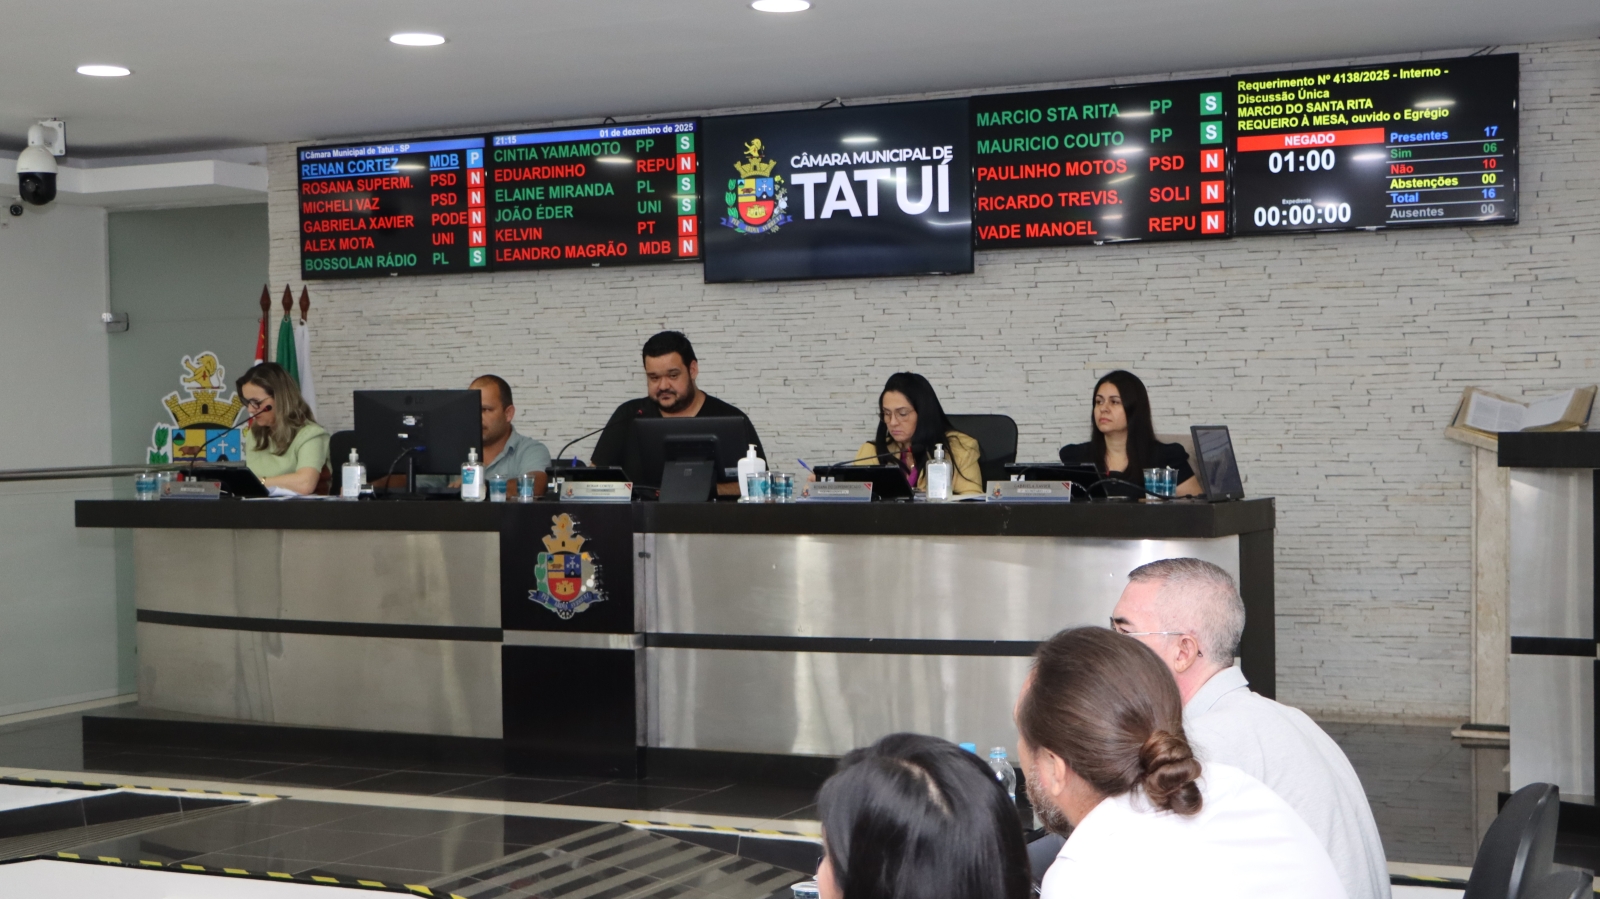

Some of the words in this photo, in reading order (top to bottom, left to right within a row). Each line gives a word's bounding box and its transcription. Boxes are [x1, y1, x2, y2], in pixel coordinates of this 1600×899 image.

[1238, 77, 1314, 91] Requerimento
[1318, 75, 1330, 85] Nº
[1333, 70, 1390, 83] 4138/2025
[1400, 67, 1440, 79] Interno
[1238, 92, 1295, 104] Discussão
[1298, 88, 1330, 100] Única
[977, 109, 1042, 126] MARCIO
[1047, 107, 1078, 122] STA
[1083, 104, 1119, 118] RITA
[1151, 100, 1172, 114] PP
[1206, 96, 1216, 111] S
[1238, 106, 1282, 117] MARCIO
[1286, 104, 1303, 114] DO
[1306, 101, 1344, 112] SANTA
[1347, 98, 1373, 110] RITA
[1238, 118, 1298, 131] REQUEIRO
[1301, 114, 1309, 126] À
[1313, 114, 1348, 126] MESA,
[1352, 110, 1390, 123] ouvido
[1404, 108, 1449, 121] Egrégio
[496, 136, 516, 144] 21:15
[623, 126, 660, 136] dezembro
[978, 136, 1059, 154] MAURICIO
[1064, 132, 1124, 148] COUTO
[1151, 129, 1172, 143] PP
[1206, 125, 1217, 140] S
[1284, 133, 1335, 146] NEGADO
[1390, 131, 1448, 143] Presentes
[1484, 126, 1497, 137] 17
[305, 151, 331, 159] Câmara
[333, 148, 365, 158] Municipal
[494, 147, 538, 162] CINTIA
[541, 142, 620, 158] YAMAMOTO
[637, 140, 654, 152] PP
[681, 137, 690, 149] S
[790, 153, 851, 168] CÂMARA
[853, 148, 931, 164] MUNICIPAL
[933, 146, 953, 159] DE
[1390, 148, 1412, 158] Sim
[1483, 143, 1497, 153] 06
[302, 163, 344, 176] RENAN
[348, 158, 399, 173] CORTEZ
[430, 154, 459, 167] MDB
[471, 152, 479, 164] P
[495, 164, 585, 182] EDUARDINHO
[637, 158, 675, 172] REPU
[681, 157, 691, 169] N
[978, 163, 1061, 181] PAULINHO
[1066, 159, 1127, 176] MOTOS
[1150, 156, 1184, 171] PSD
[1206, 154, 1218, 168] N
[1268, 149, 1335, 173] 01:00
[1390, 163, 1413, 174] Não
[1483, 158, 1496, 169] 10
[302, 181, 353, 194] ROSANA
[357, 176, 413, 191] SUPERM.
[431, 174, 456, 186] PSD
[471, 172, 480, 184] N
[496, 187, 544, 202] ELAINE
[549, 183, 614, 198] MIRANDA
[637, 180, 654, 193] PL
[682, 178, 690, 190] S
[791, 157, 953, 220] TATUÍ
[1390, 177, 1458, 189] Abstenções
[1482, 174, 1496, 184] 00
[303, 199, 352, 213] MICHELI
[356, 198, 379, 210] VAZ
[431, 193, 457, 206] PSD
[472, 192, 481, 204] N
[978, 193, 1053, 211] RICARDO
[1058, 190, 1122, 206] TREVIS.
[1150, 186, 1190, 202] SOLI
[1207, 185, 1218, 199] N
[1391, 192, 1419, 203] Total
[1482, 189, 1495, 199] 16
[495, 205, 532, 222] JOÃO
[536, 205, 573, 219] ÉDER
[638, 201, 661, 214] UNI
[682, 199, 691, 211] S
[1254, 203, 1351, 226] 00:00:00
[1390, 207, 1444, 219] Ausentes
[1481, 204, 1495, 214] 00
[304, 219, 366, 233] GABRIELA
[370, 216, 414, 229] XAVIER
[432, 212, 467, 226] PODE
[472, 212, 481, 223] N
[496, 228, 542, 241] KELVIN
[638, 221, 655, 234] PT
[683, 220, 692, 232] N
[978, 224, 1020, 240] VADE
[1026, 221, 1097, 237] MANOEL
[1150, 216, 1196, 232] REPU
[1207, 215, 1218, 229] N
[305, 239, 335, 251] ALEX
[340, 237, 374, 250] MOTA
[432, 233, 454, 245] UNI
[473, 231, 482, 243] N
[496, 247, 560, 261] LEANDRO
[565, 241, 627, 258] MAGRÃO
[640, 241, 670, 254] MDB
[683, 240, 692, 253] N
[305, 256, 372, 271] BOSSOLAN
[377, 252, 416, 267] RÁDIO
[433, 253, 449, 265] PL
[473, 251, 482, 263] S
